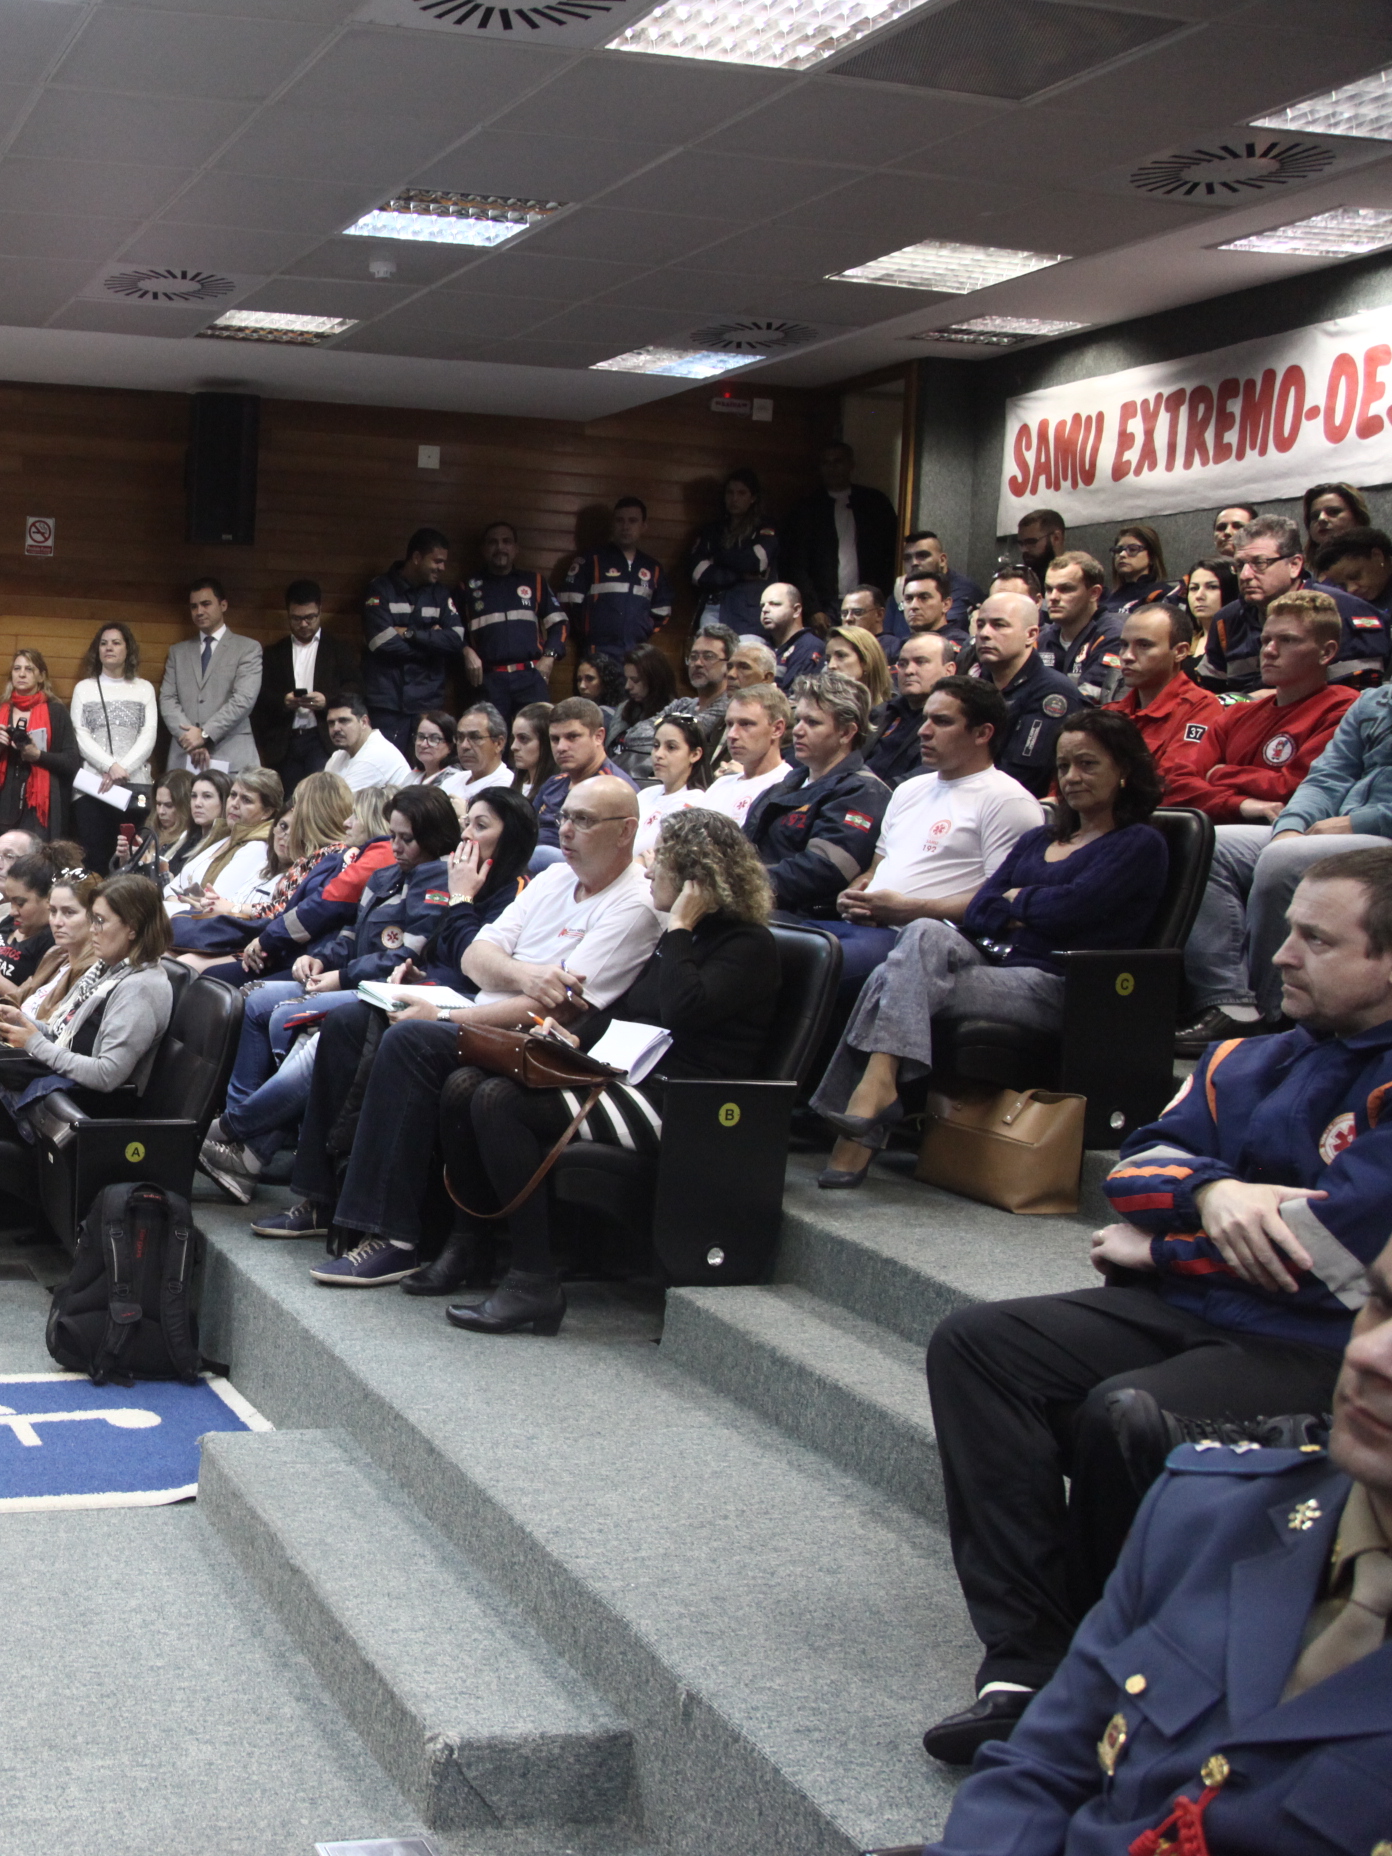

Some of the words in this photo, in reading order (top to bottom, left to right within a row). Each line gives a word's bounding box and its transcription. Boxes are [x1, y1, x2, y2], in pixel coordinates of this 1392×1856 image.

[1008, 411, 1105, 499] SAMU
[1110, 343, 1392, 484] EXTREMO-OE
[1189, 726, 1204, 739] 37
[922, 844, 937, 853] 192
[1120, 978, 1130, 991] C
[725, 1108, 735, 1121] B
[131, 1146, 141, 1158] A
